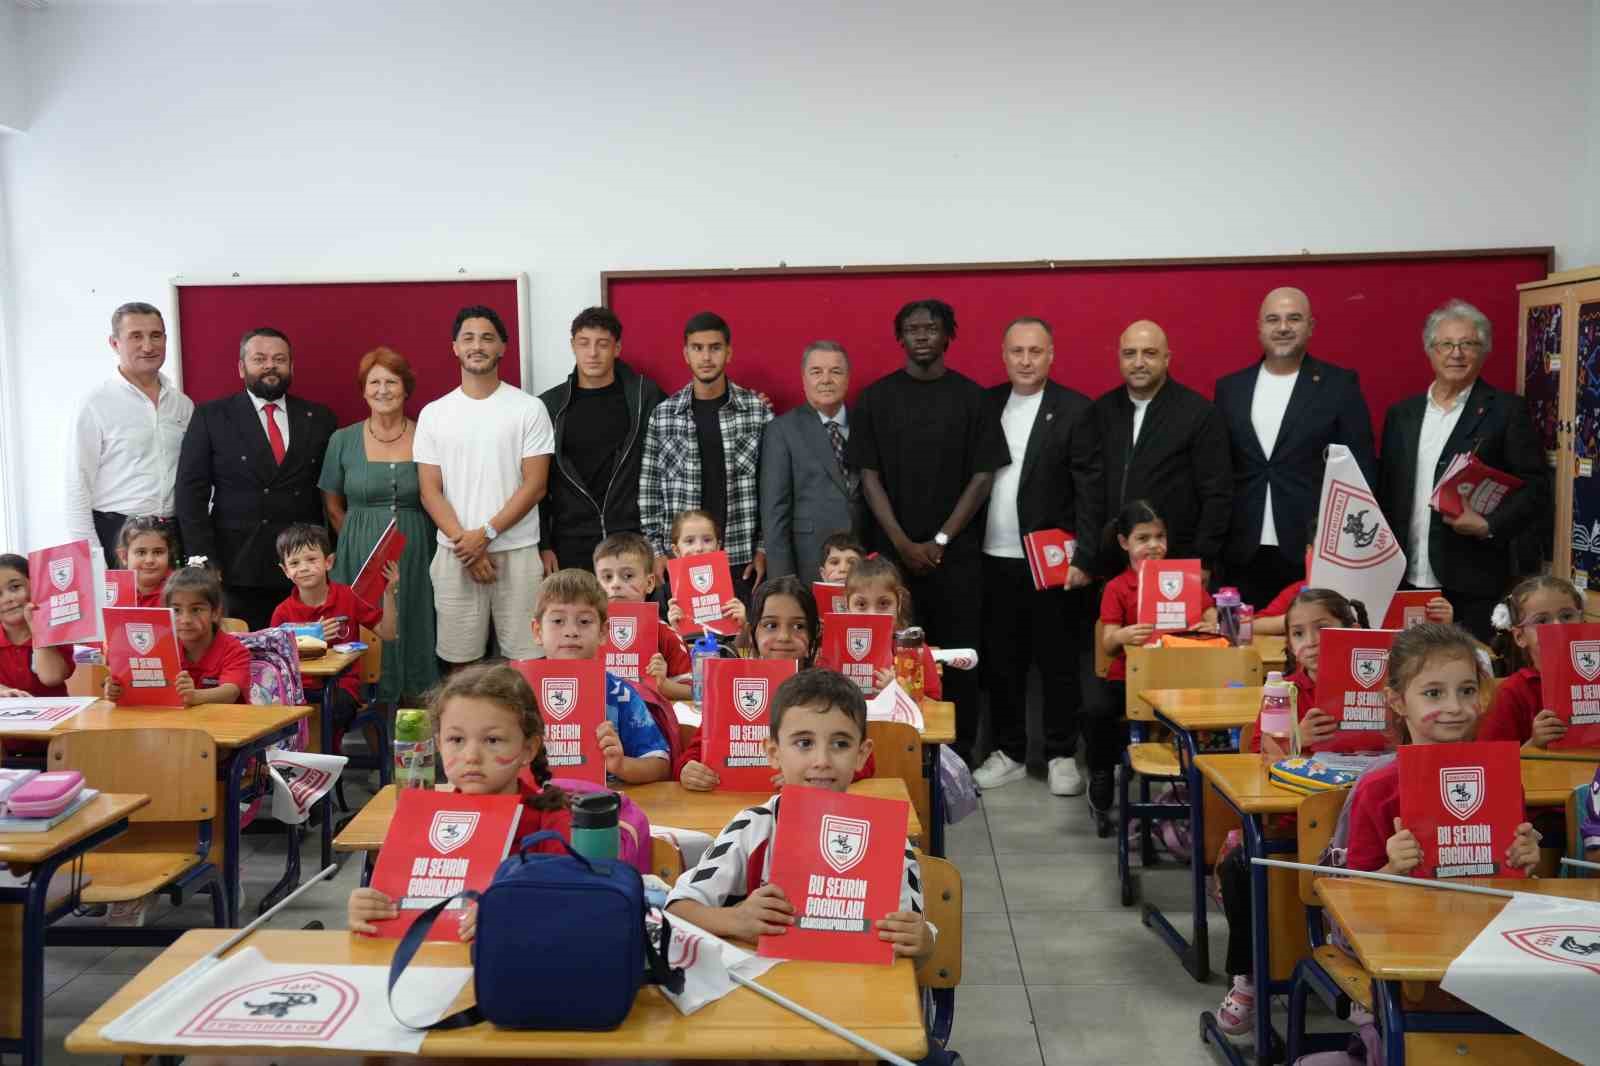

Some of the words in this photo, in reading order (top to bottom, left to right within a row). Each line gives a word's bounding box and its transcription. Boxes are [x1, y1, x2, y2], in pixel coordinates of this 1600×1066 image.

[1453, 823, 1491, 848] ŞEHRİN
[1439, 845, 1492, 865] ÇOCUKLARI
[807, 874, 826, 896] BU
[825, 876, 868, 900] ŞEHRİN
[804, 896, 866, 920] ÇOCUKLARI
